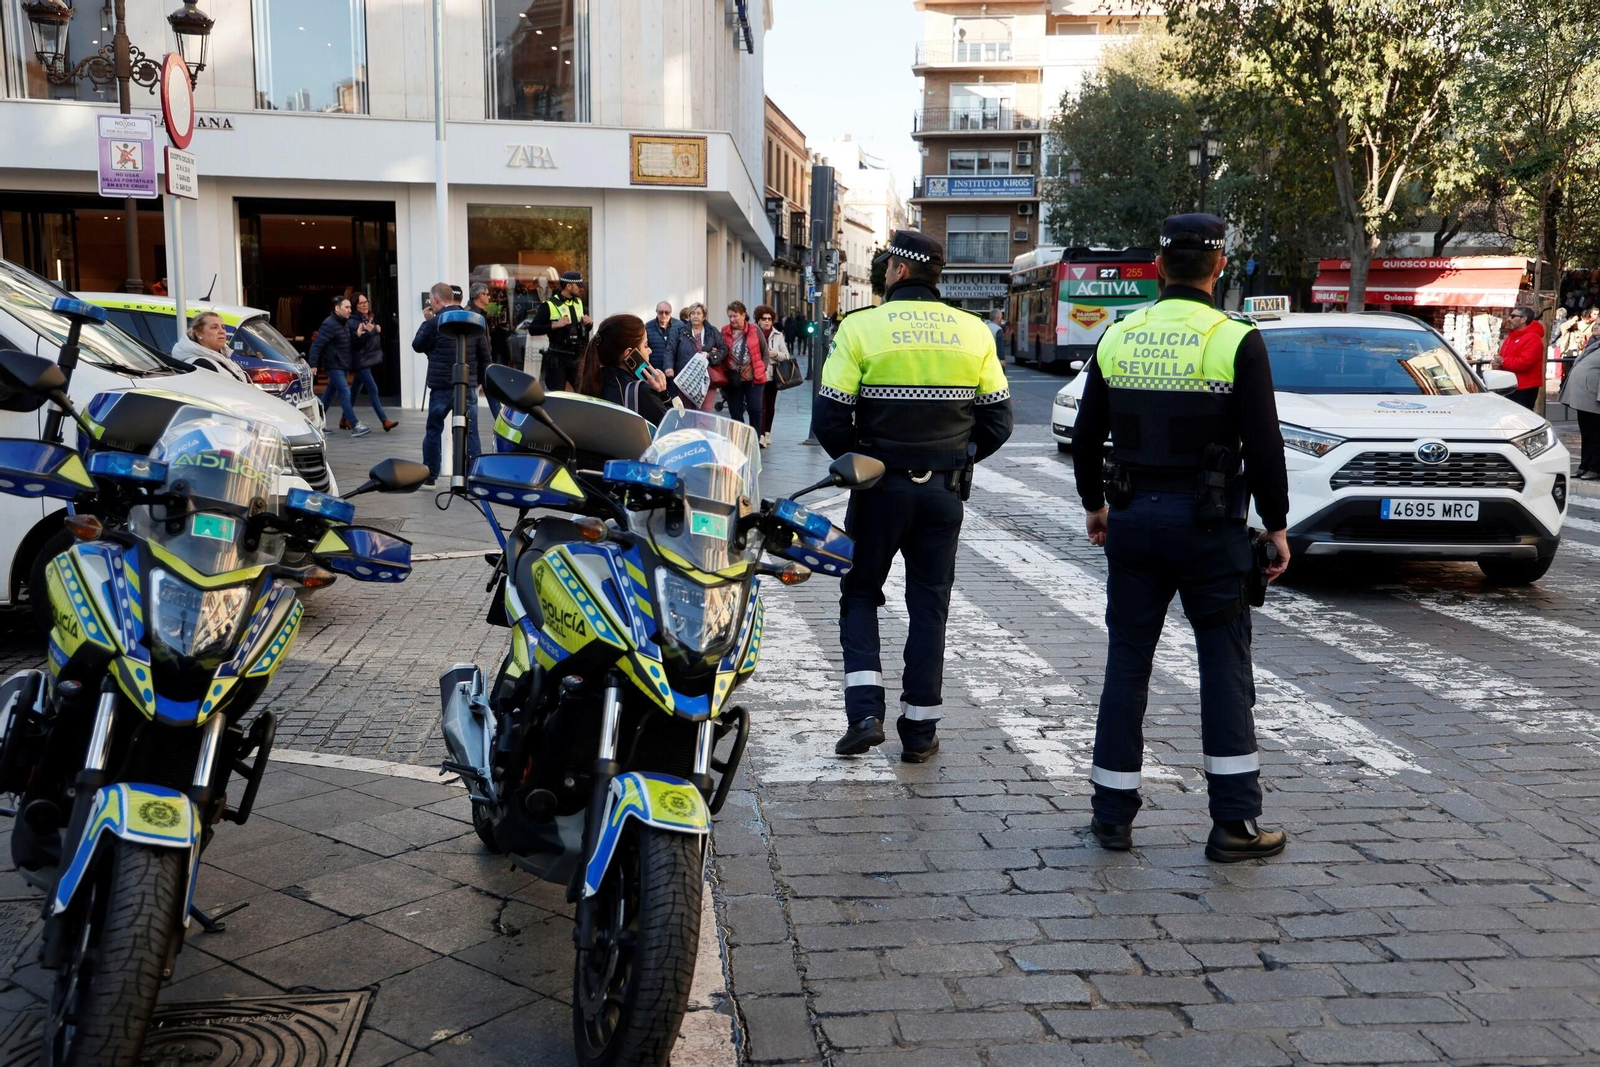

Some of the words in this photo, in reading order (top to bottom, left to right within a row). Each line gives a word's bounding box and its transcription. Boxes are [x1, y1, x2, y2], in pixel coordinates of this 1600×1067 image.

[506, 145, 558, 169] ZARA
[954, 179, 1000, 187] INSTITUTO
[1003, 178, 1030, 187] KIROS
[1383, 260, 1427, 268] QUIOSCO
[954, 274, 996, 285] DUQUE
[1100, 269, 1116, 278] 27
[1126, 268, 1143, 277] 255
[1075, 281, 1139, 295] ACTIVIA
[1254, 298, 1277, 310] TAXI
[888, 311, 958, 324] POLICIA
[891, 330, 961, 346] SEVILLA
[1123, 331, 1199, 347] POLICIA
[1133, 348, 1178, 359] LOCAL
[1117, 360, 1195, 376] SEVILLA
[1394, 502, 1435, 517] 4695
[1442, 503, 1474, 518] MRC
